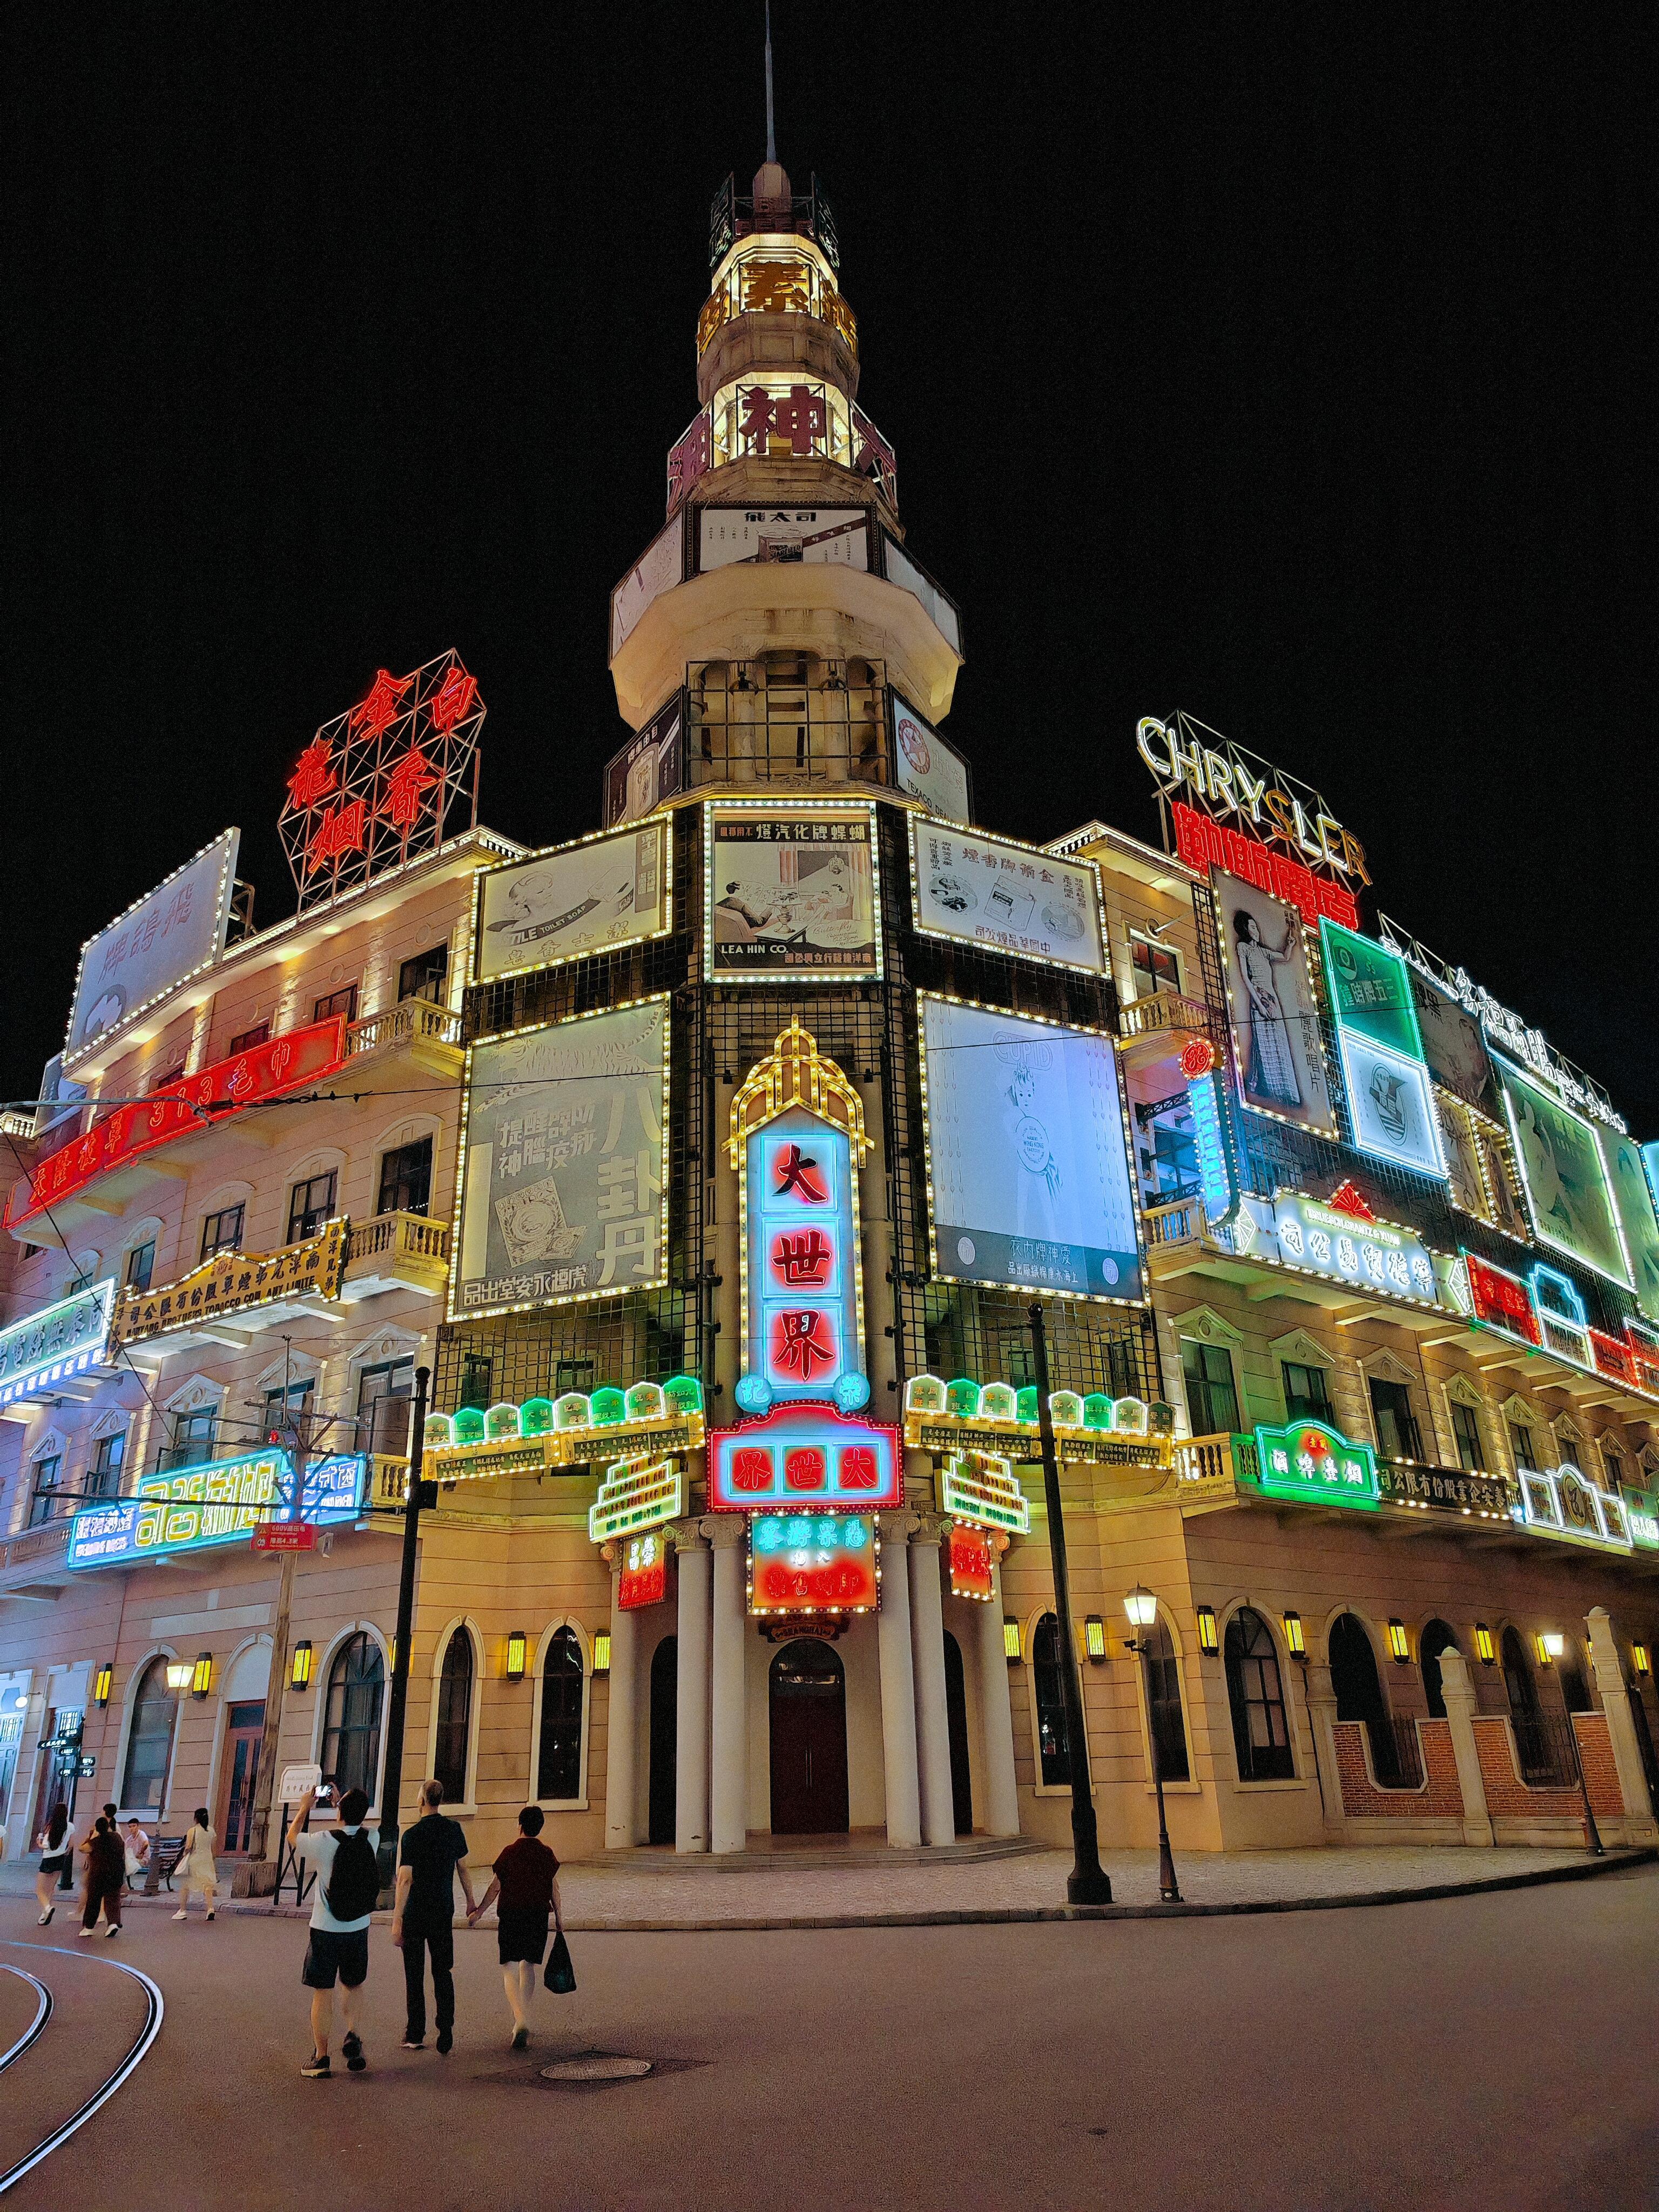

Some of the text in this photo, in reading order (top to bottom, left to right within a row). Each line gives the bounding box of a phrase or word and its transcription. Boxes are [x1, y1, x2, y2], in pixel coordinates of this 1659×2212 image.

[740, 386, 826, 454] 神
[907, 778, 933, 808] TEXACO
[1137, 717, 1373, 885] CHRYSLER
[540, 918, 567, 934] TOILET
[567, 905, 586, 921] SOAP
[721, 945, 788, 954] LEA HIN CO.
[995, 1033, 1051, 1068] CUPID
[772, 1143, 835, 1381] 大世界
[205, 1297, 241, 1314] TOBACCO
